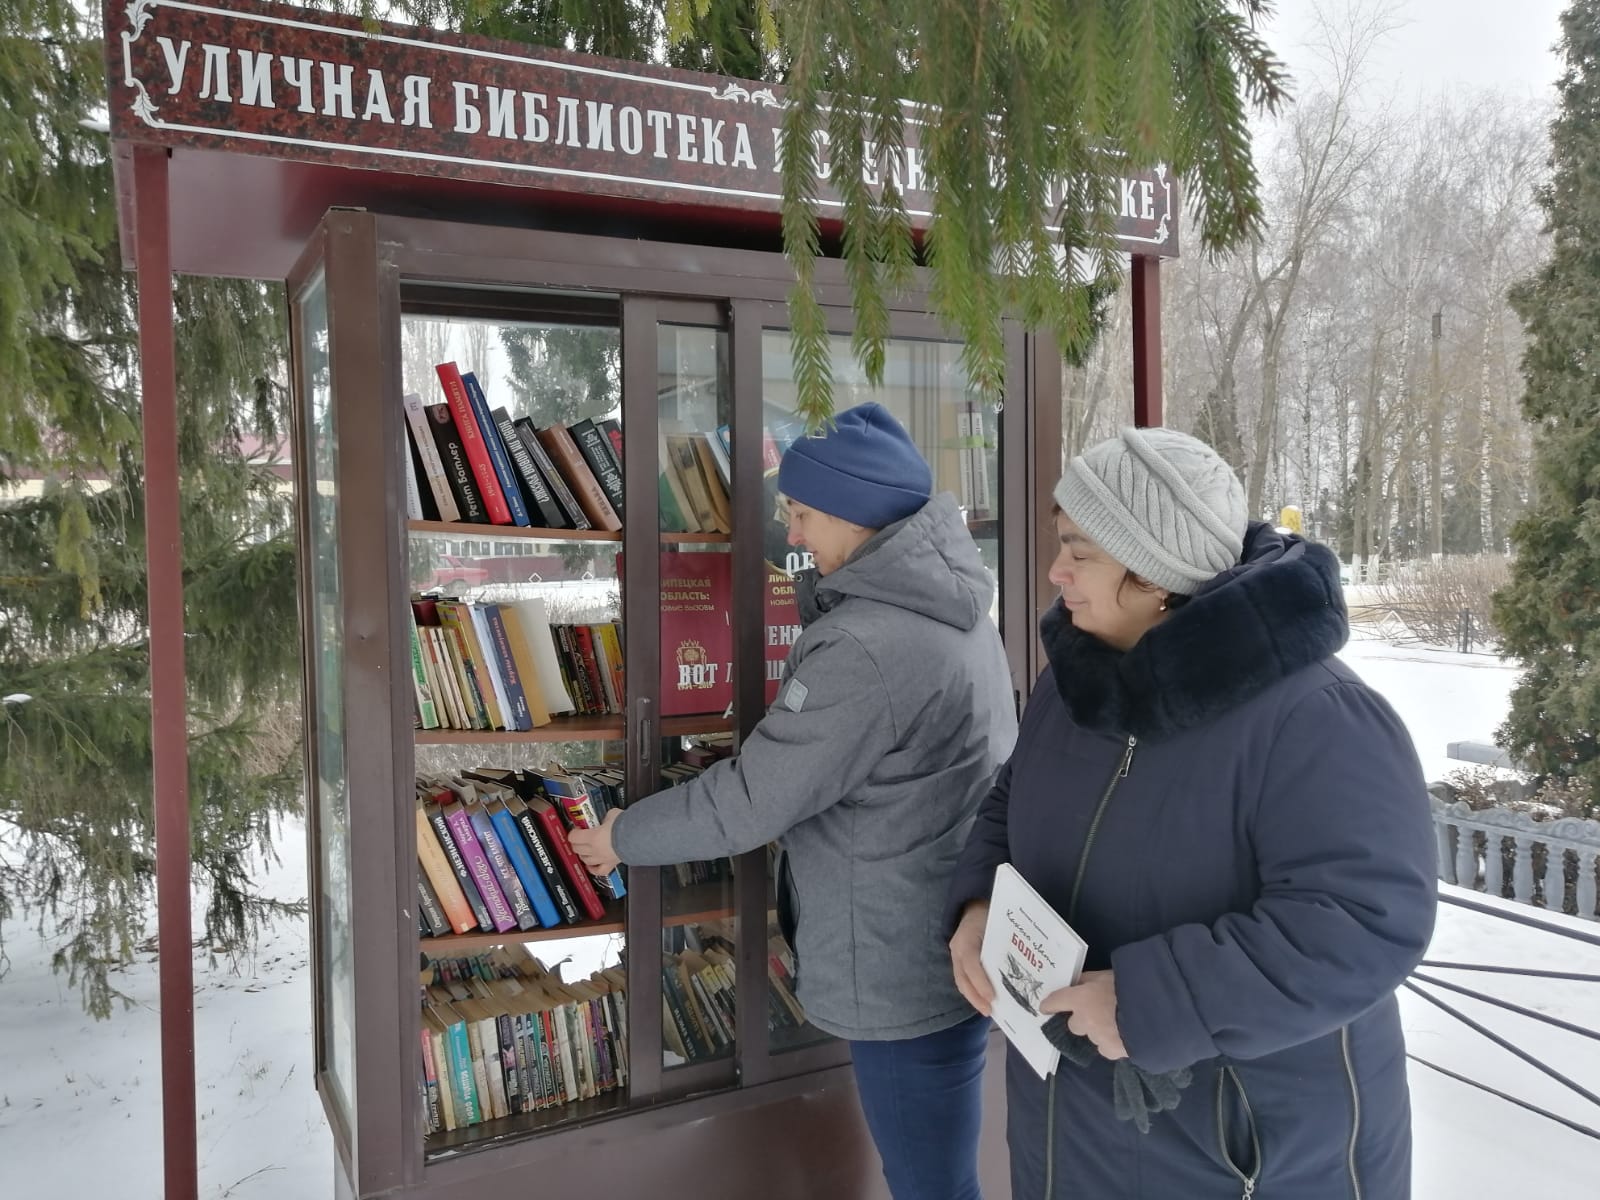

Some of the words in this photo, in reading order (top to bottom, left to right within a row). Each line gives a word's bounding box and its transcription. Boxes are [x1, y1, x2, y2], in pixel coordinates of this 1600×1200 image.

[157, 36, 433, 129] УЛИЧНАЯ
[452, 80, 757, 170] БИБЛИОТЕКА
[499, 419, 514, 442] НОВА
[506, 438, 522, 453] ЛИ
[512, 450, 534, 476] НОВАЯ
[660, 578, 712, 588] ИПЕЦКАЯ
[678, 663, 718, 685] ВОТ
[433, 817, 467, 877] Ф.НЕЗНАНСКИЙ
[520, 816, 553, 875] Ф.НЕЗНАНСКИЙ
[1011, 932, 1043, 972] БОЛЬ?
